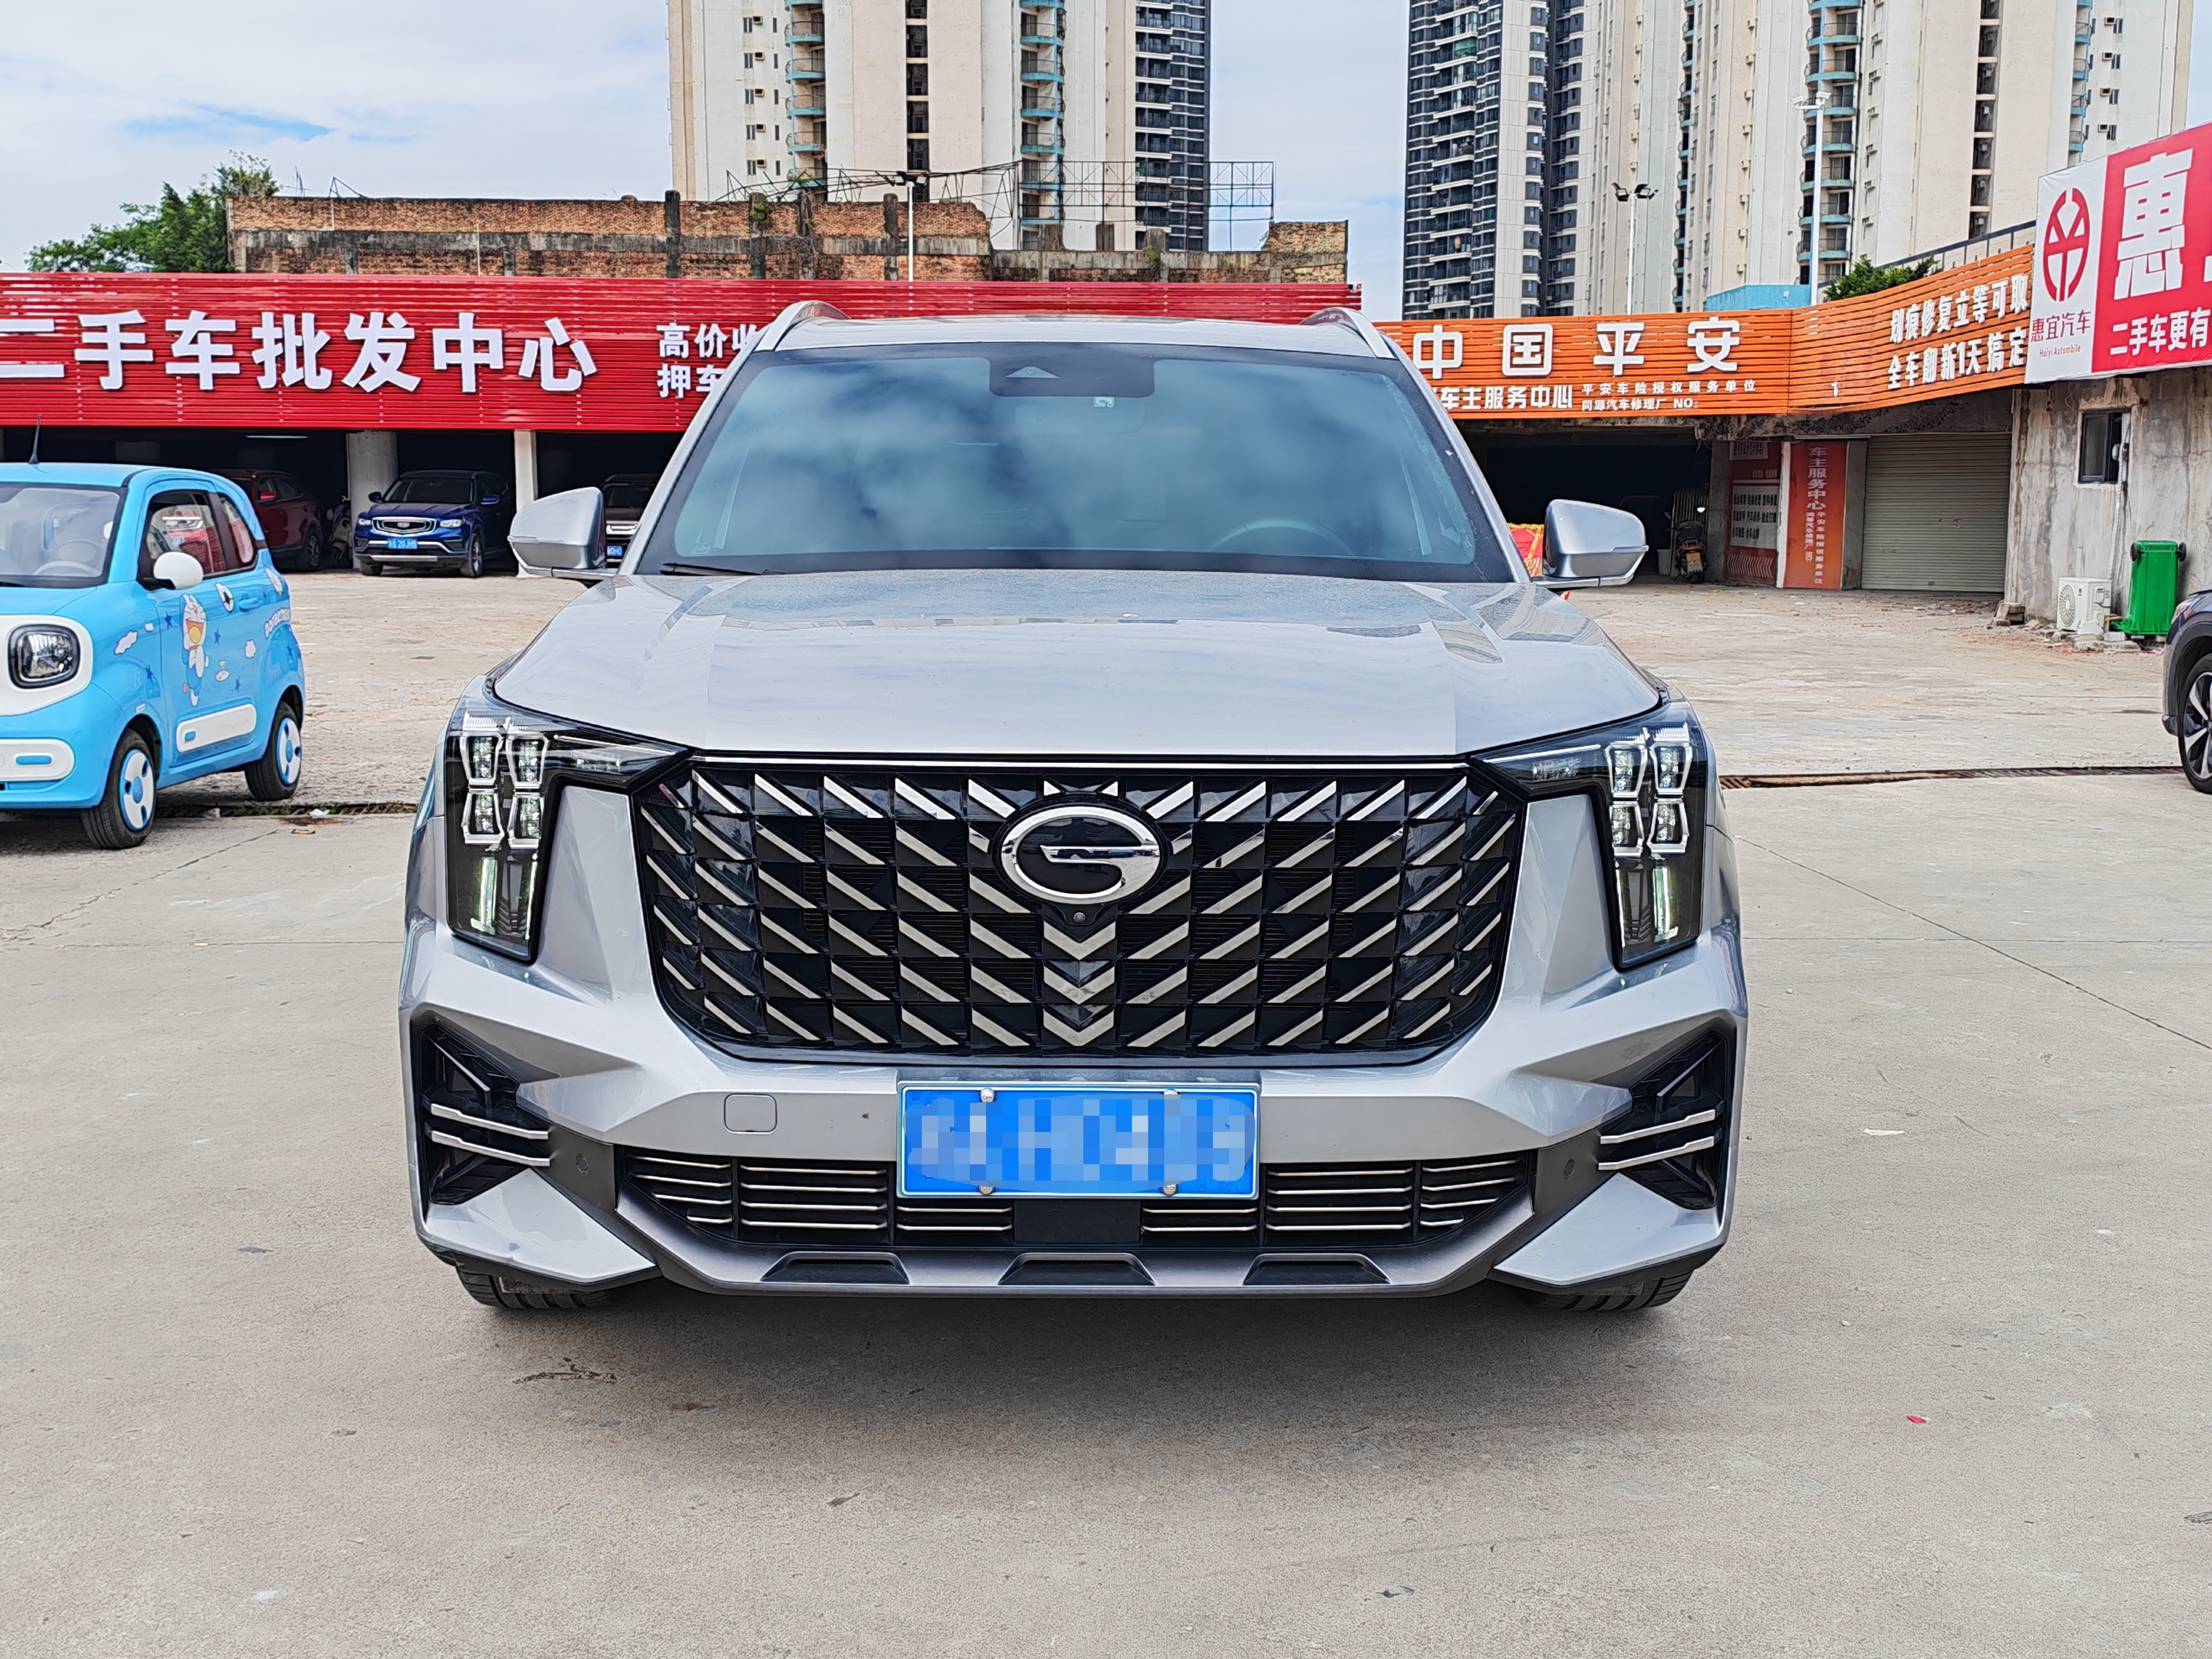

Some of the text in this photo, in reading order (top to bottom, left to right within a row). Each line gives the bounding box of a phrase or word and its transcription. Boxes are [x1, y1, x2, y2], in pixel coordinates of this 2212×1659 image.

[2114, 148, 2212, 300] 惠
[1413, 317, 1740, 379] 中国平安
[2031, 309, 2091, 342] 惠宜汽车
[2110, 307, 2211, 356] 二手车更有
[0, 310, 597, 393] 二手车批发中心
[1433, 385, 1573, 410] 车主服务中心
[1582, 379, 1756, 396] 平安车险授权服务单位
[1582, 397, 1667, 411] 同源汽车修理厂
[1806, 447, 1827, 510] 车主服务中心
